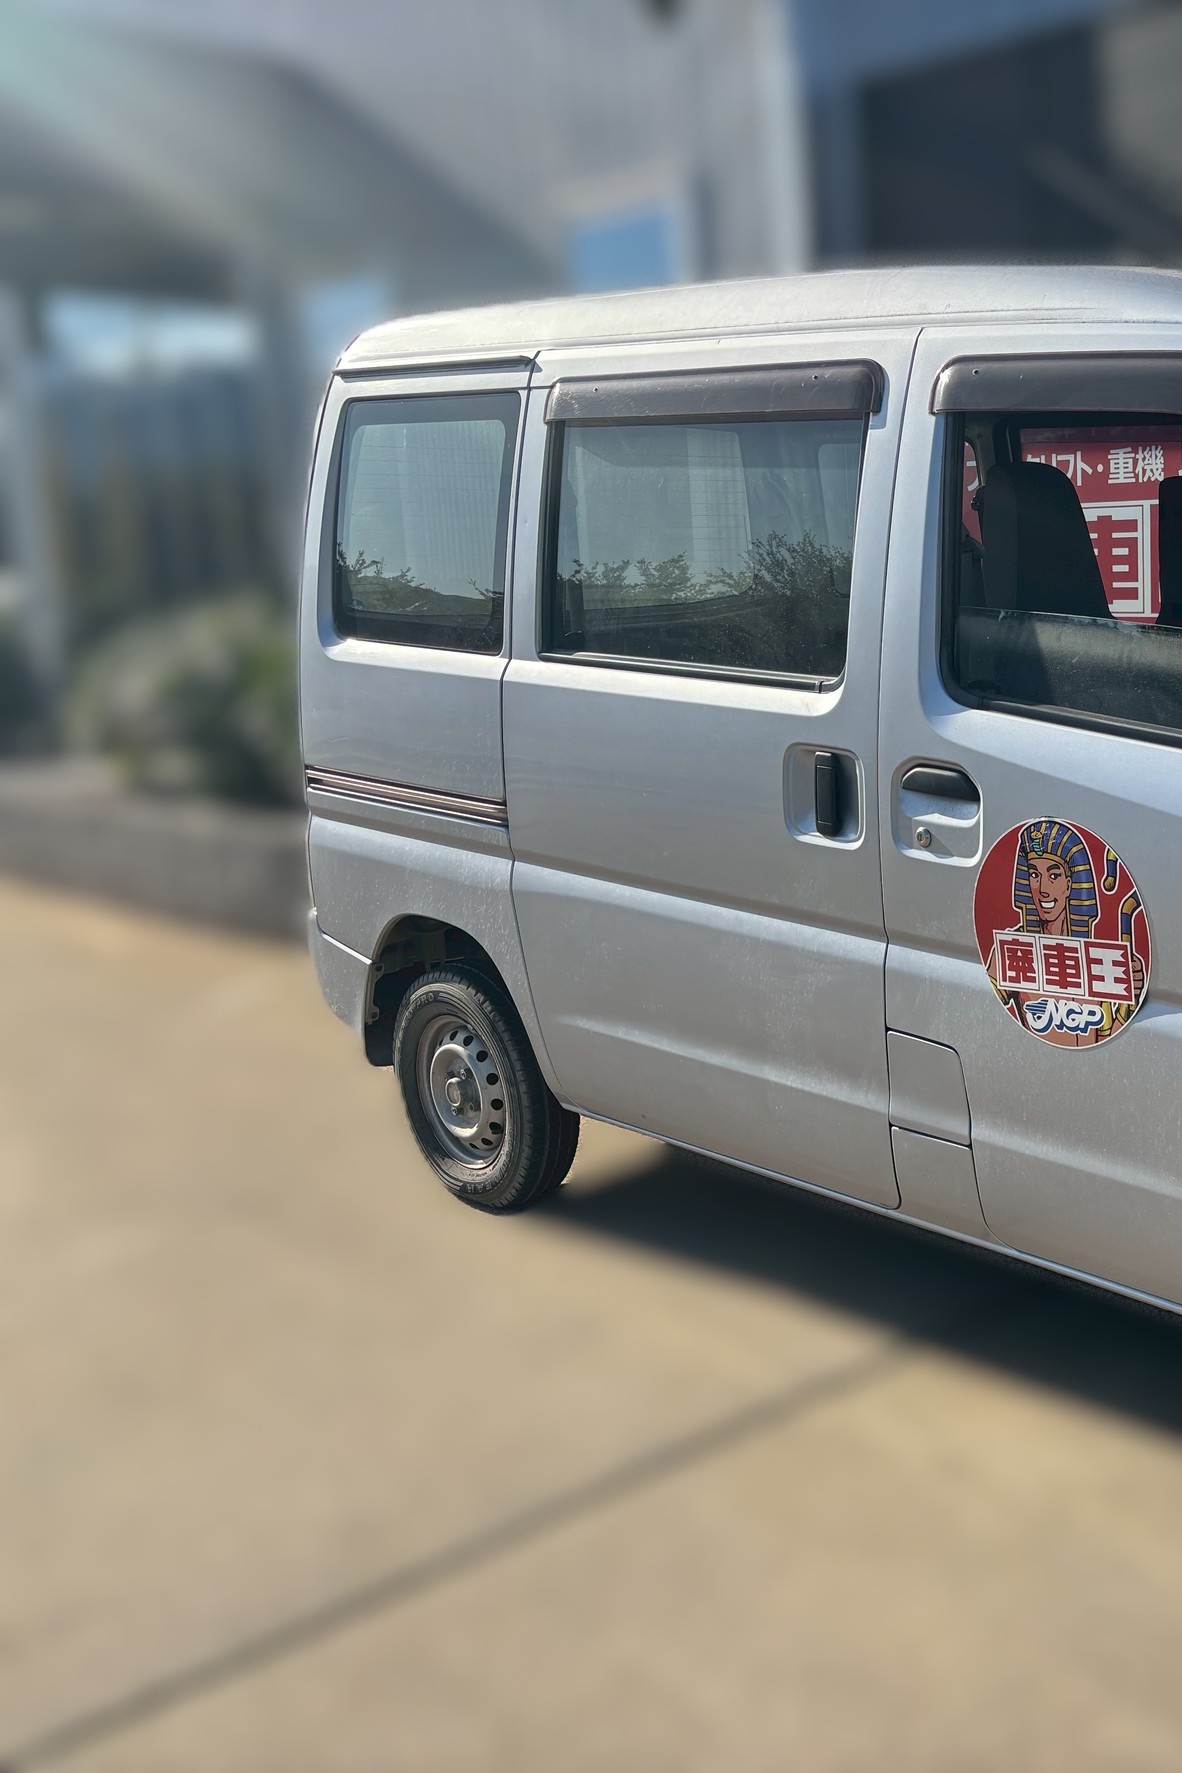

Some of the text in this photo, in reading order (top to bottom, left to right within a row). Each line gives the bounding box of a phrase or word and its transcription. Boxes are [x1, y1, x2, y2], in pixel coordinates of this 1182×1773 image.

[995, 931, 1134, 1003] 廃車王
[1024, 998, 1105, 1035] NGP
